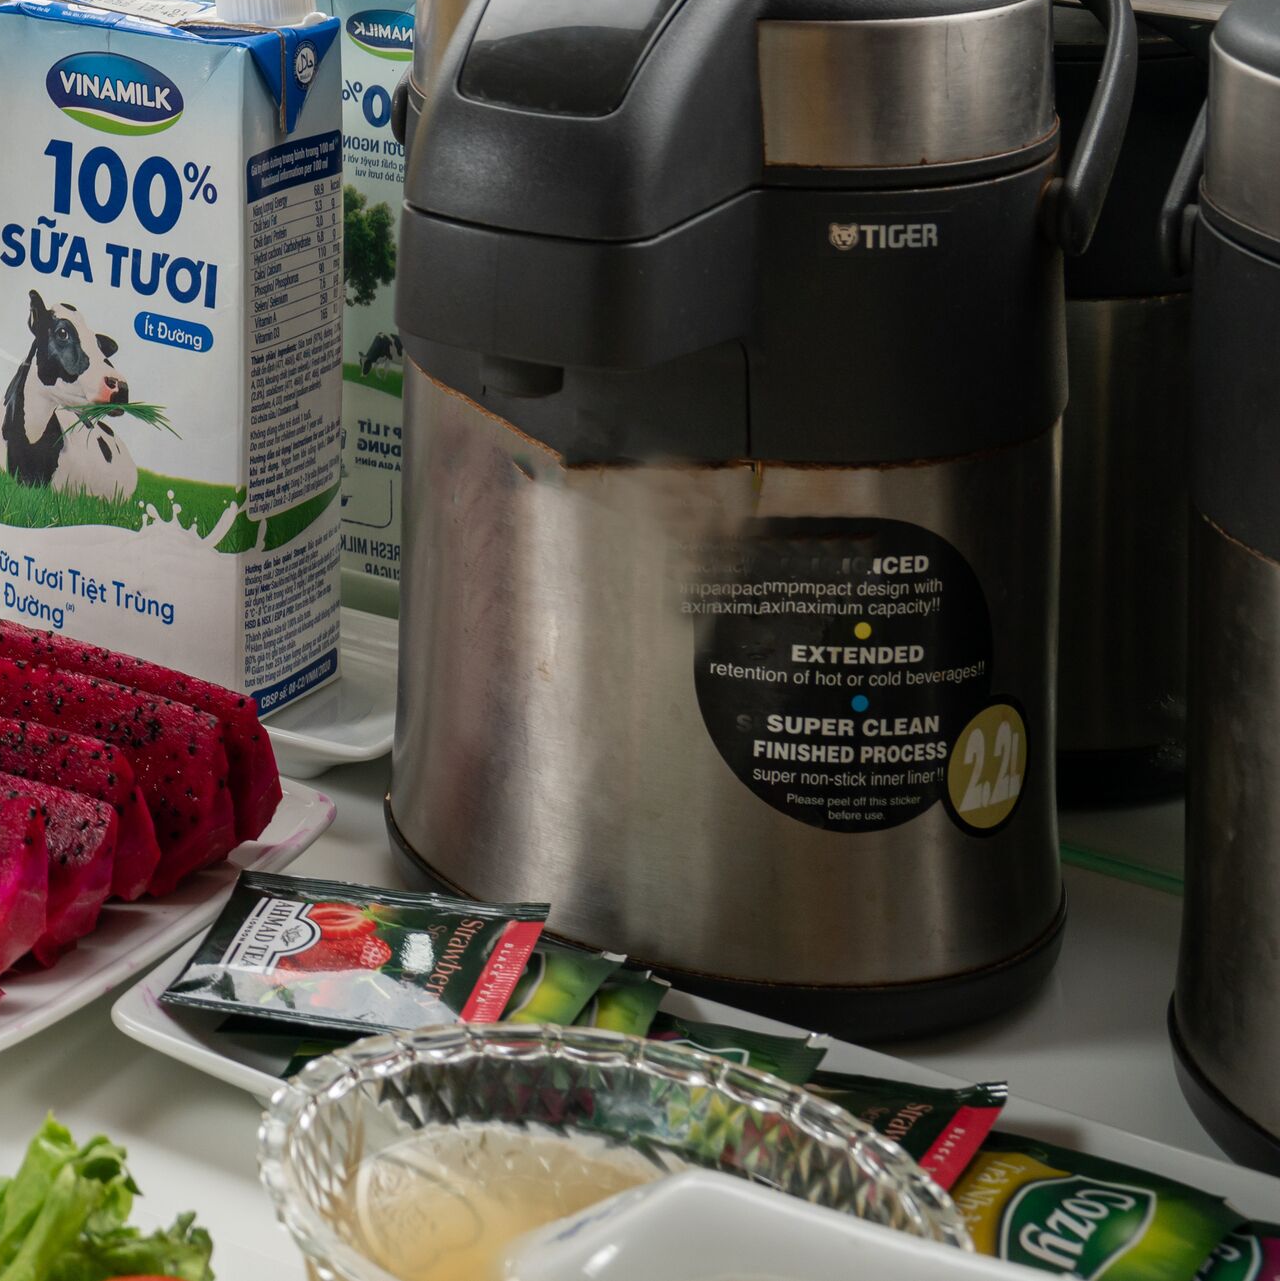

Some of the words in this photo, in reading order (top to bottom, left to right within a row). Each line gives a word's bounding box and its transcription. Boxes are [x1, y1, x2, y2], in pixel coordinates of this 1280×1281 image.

[59, 70, 173, 111] VINAMILK
[43, 138, 218, 235] 100%
[860, 223, 938, 249] TIGER
[0, 214, 93, 283] SỮA
[106, 242, 218, 309] TƯƠI
[143, 314, 154, 337] Ít
[157, 320, 203, 350] Đường
[24, 555, 63, 591] Tươi
[68, 569, 107, 604] Tiệt
[112, 581, 174, 625] Trùng
[856, 580, 910, 599] design
[914, 578, 943, 594] with
[867, 598, 941, 618] capacity!!
[791, 644, 925, 665] EXTENDED
[709, 661, 788, 683] retention
[793, 670, 810, 685] of
[815, 670, 842, 687] hot
[846, 674, 864, 687] or
[868, 670, 901, 687] cold
[906, 661, 985, 686] beverages!!
[261, 690, 278, 709] CBSP
[767, 714, 855, 737] SUPER
[862, 715, 940, 737] CLEAN
[753, 740, 855, 764] FINISHED
[860, 741, 948, 764] PROCESS
[753, 768, 795, 785] super
[801, 770, 867, 787] non-stick
[870, 770, 904, 786] inner
[786, 793, 825, 806] Please
[827, 796, 851, 811] peel
[853, 796, 868, 806] off
[869, 796, 887, 806] this
[890, 795, 921, 806] sticker
[828, 810, 862, 821] before
[254, 900, 296, 944] AHMAD
[241, 944, 268, 967] TEA
[489, 943, 514, 976] BLACK
[476, 982, 495, 1003] TEA
[933, 1127, 966, 1162] BLACK
[1019, 1189, 1137, 1270] Cozy
